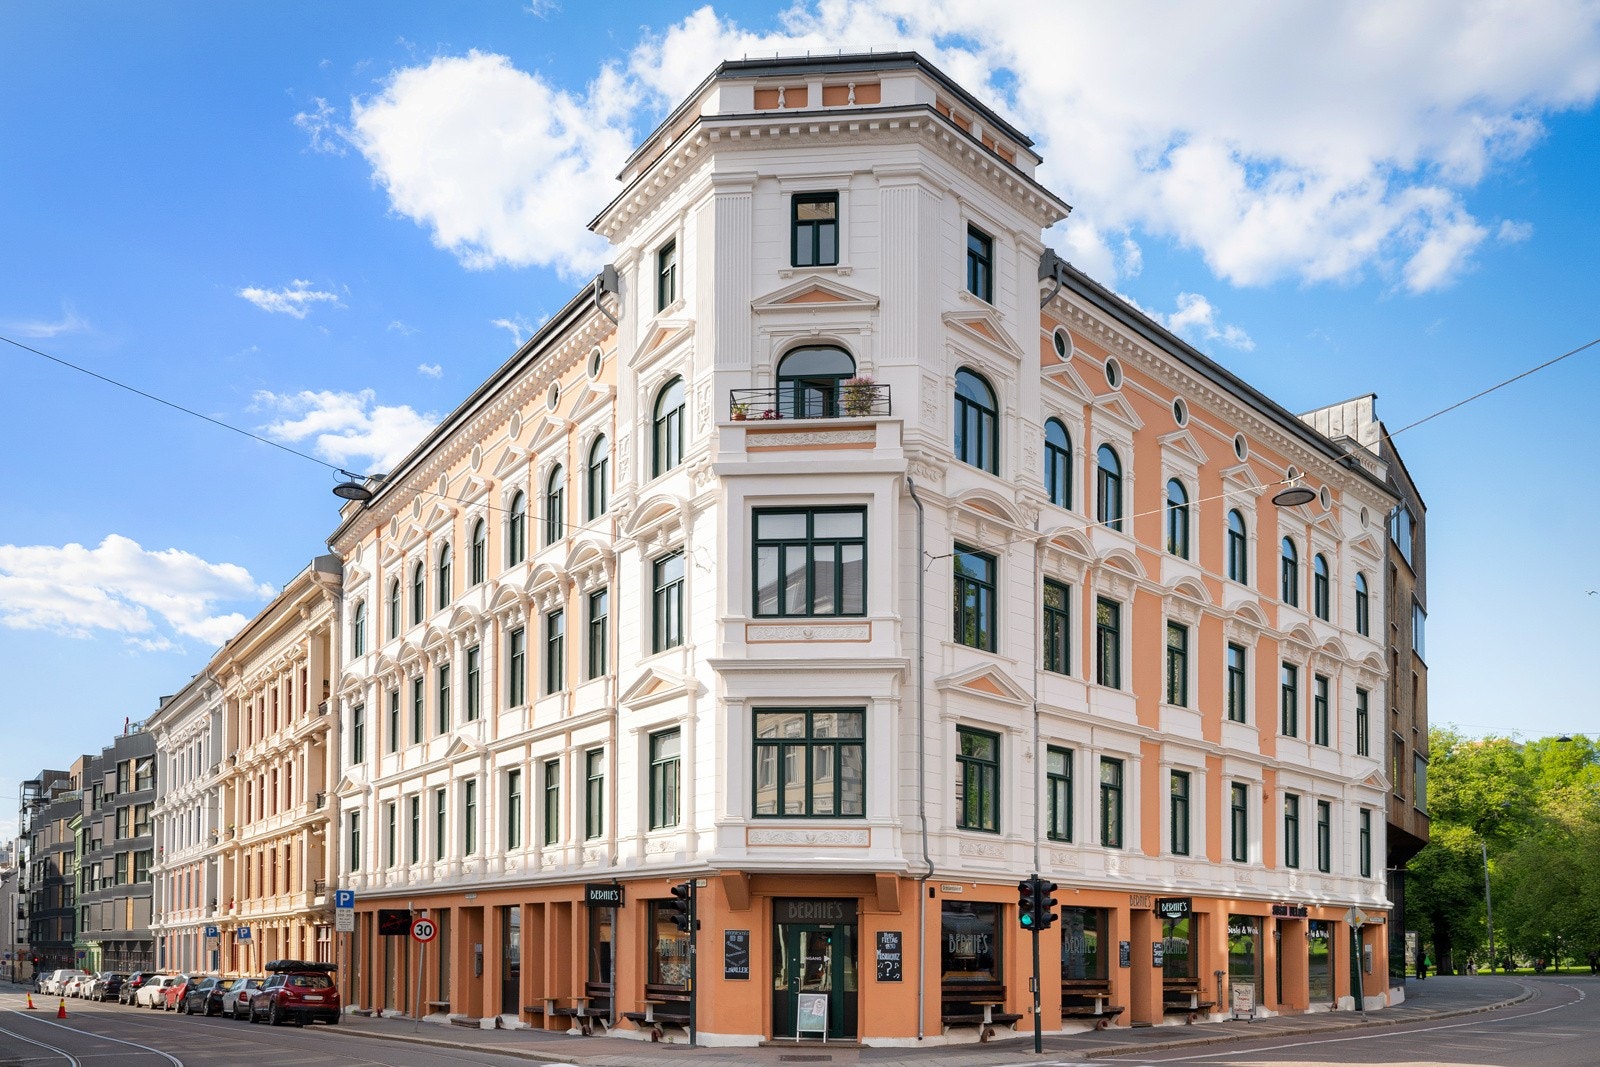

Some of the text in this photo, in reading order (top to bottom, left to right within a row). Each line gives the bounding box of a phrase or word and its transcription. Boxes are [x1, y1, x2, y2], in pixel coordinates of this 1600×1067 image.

[340, 892, 350, 906] P
[590, 890, 619, 900] BERNIE'S
[788, 901, 843, 919] BERNIE'S
[1161, 901, 1187, 912] BERNIE'S
[208, 928, 215, 936] P
[240, 928, 248, 938] P
[416, 924, 433, 937] 30
[949, 933, 988, 954] BERNIE'S
